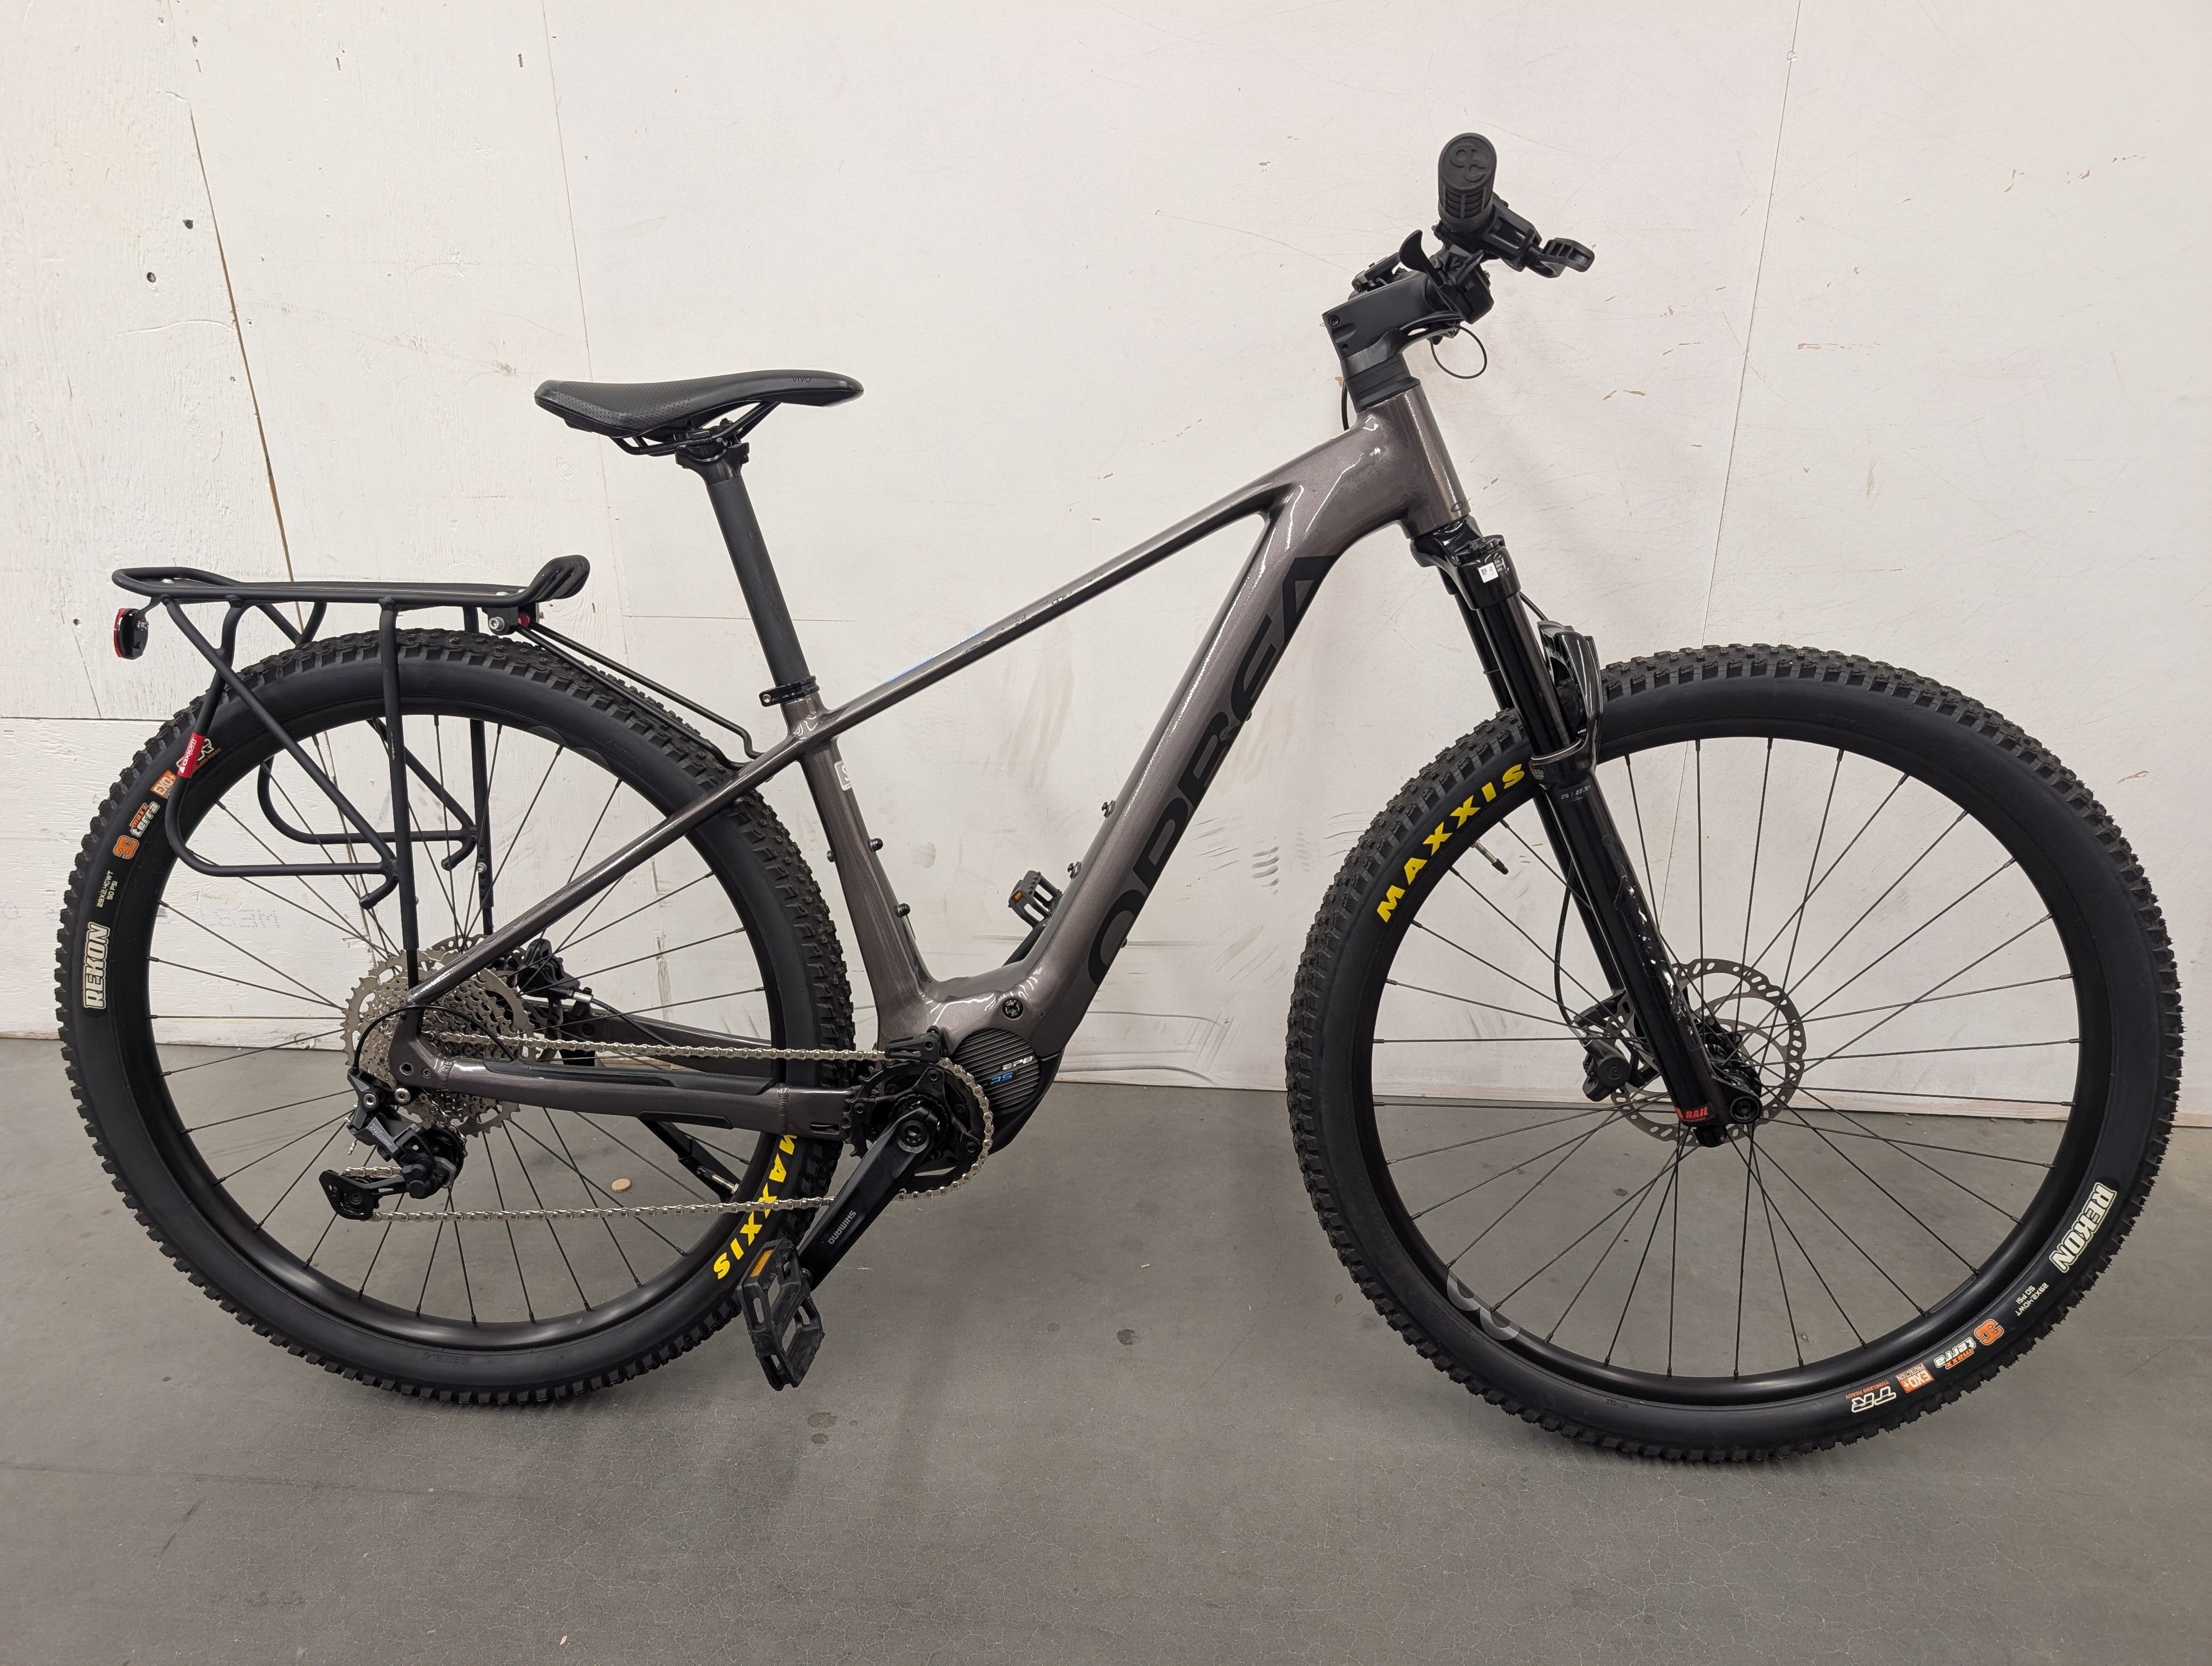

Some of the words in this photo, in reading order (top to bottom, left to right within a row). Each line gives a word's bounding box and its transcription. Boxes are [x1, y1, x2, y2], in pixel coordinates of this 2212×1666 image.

[183, 736, 197, 766] axiom
[1087, 554, 1338, 985] ORBEA
[152, 773, 177, 796] EXO+
[130, 803, 150, 829] maxx
[130, 802, 160, 837] terra
[113, 835, 140, 860] 3C
[1377, 764, 1525, 923] MAXXIS
[107, 891, 114, 900] 50
[110, 880, 118, 890] PSI
[83, 922, 110, 1009] REKON
[369, 1125, 393, 1148] DEORE
[713, 1135, 798, 1280] MAXXIS
[827, 1209, 857, 1245] SHIMANO
[2049, 1182, 2117, 1273] REKON
[2015, 1293, 2028, 1304] PSI
[2015, 1282, 2049, 1316] 29X2.40WT
[2024, 1285, 2036, 1296] 50
[1973, 1318, 2004, 1346] 3C
[1933, 1337, 1976, 1368] terra
[1945, 1348, 1974, 1369] maxx
[1896, 1362, 1926, 1381] PROTECTION
[1903, 1370, 1931, 1389] EXO+
[1845, 1391, 1862, 1399] READY
[1851, 1386, 1896, 1413] TR
[1863, 1380, 1889, 1393] TUBELESS
